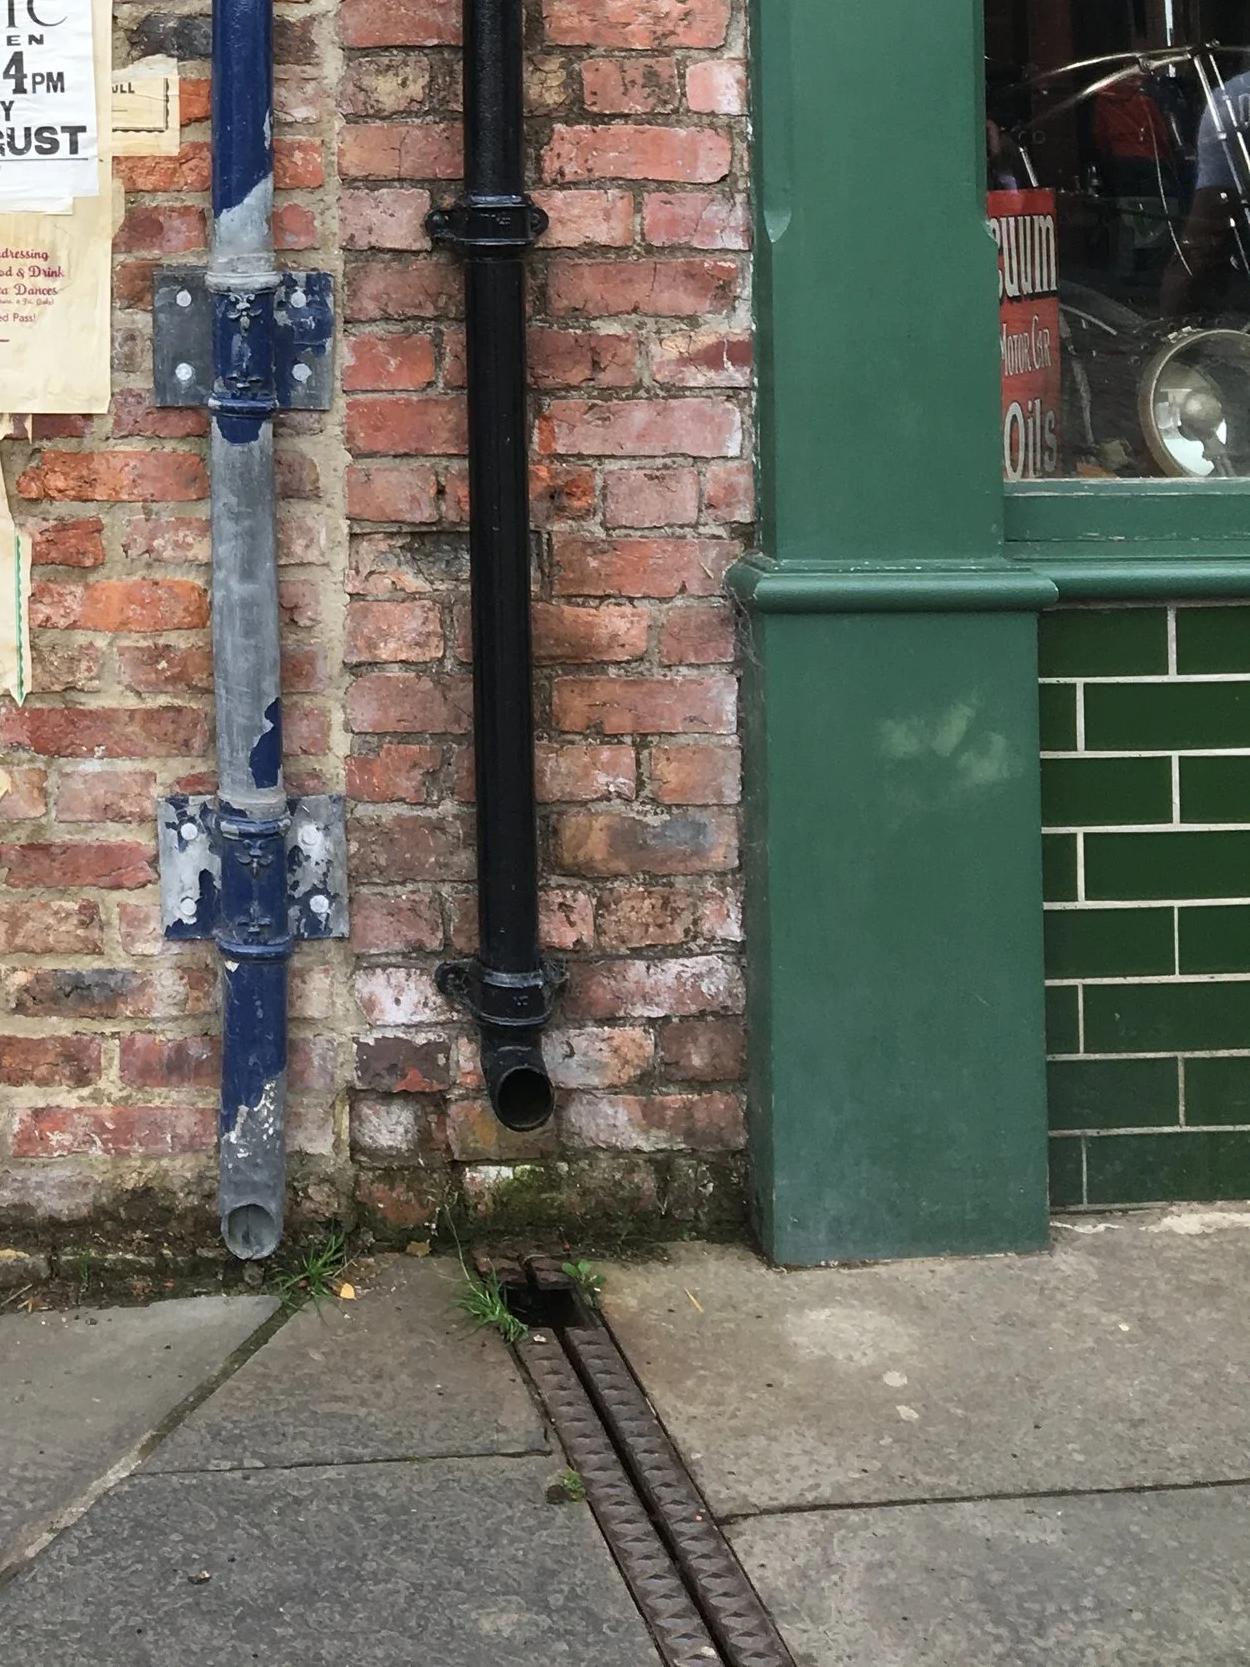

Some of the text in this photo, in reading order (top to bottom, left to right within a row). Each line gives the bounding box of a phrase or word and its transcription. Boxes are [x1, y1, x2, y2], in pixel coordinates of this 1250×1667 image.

[2, 51, 65, 95] 4PM
[16, 266, 24, 279] &
[28, 265, 64, 278] Drink
[13, 283, 58, 296] Dances
[13, 313, 36, 323] Pass!
[1004, 398, 1057, 479] Oils
